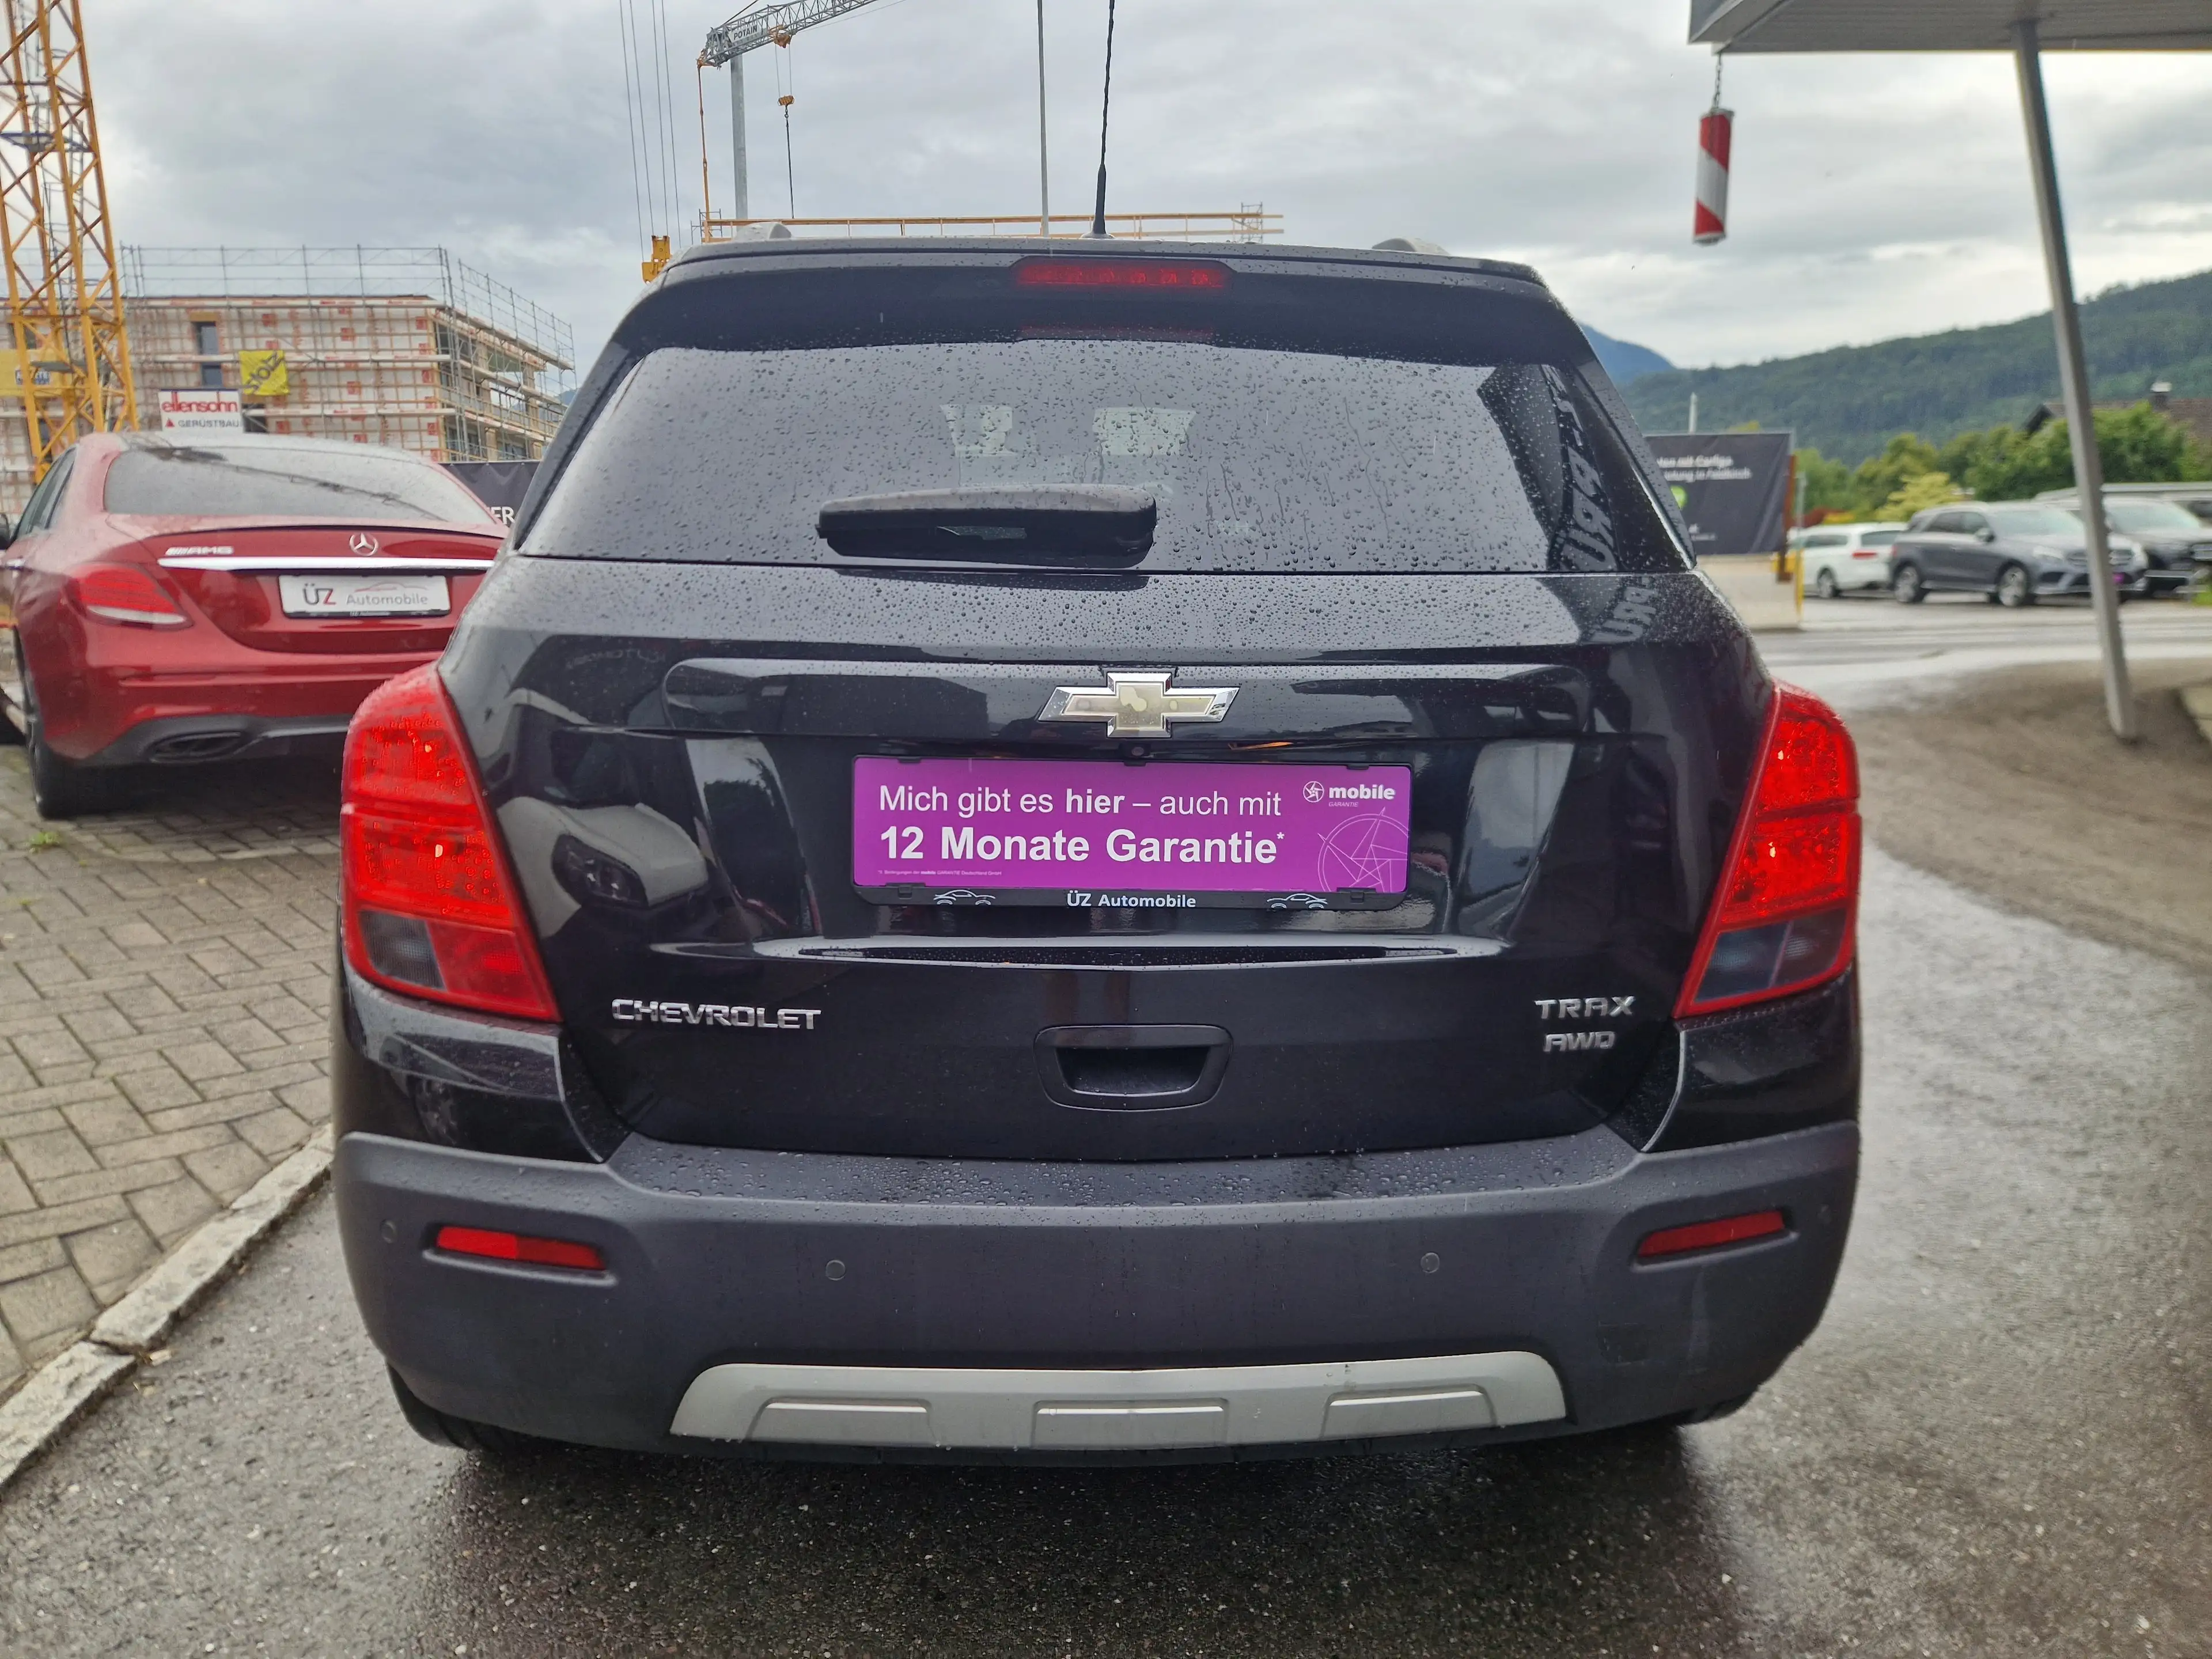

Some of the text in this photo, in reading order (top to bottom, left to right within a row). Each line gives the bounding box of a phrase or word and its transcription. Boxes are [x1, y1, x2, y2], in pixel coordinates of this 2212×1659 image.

[734, 25, 757, 40] POTAIN
[302, 582, 429, 605] ÜZ Automobile
[880, 785, 948, 811] Mich
[958, 787, 1011, 819] gibt
[1020, 793, 1054, 813] es
[1066, 789, 1125, 813] hier
[1160, 791, 1228, 815] auch
[1240, 791, 1281, 816] mit
[1329, 784, 1396, 800] mobile
[881, 826, 924, 859] 12
[941, 827, 1090, 861] Monate
[1067, 890, 1196, 907] ÜZ Automobile
[612, 998, 821, 1029] CHEVROLET
[1534, 995, 1636, 1019] TRAX
[1543, 1031, 1615, 1052] AWD
